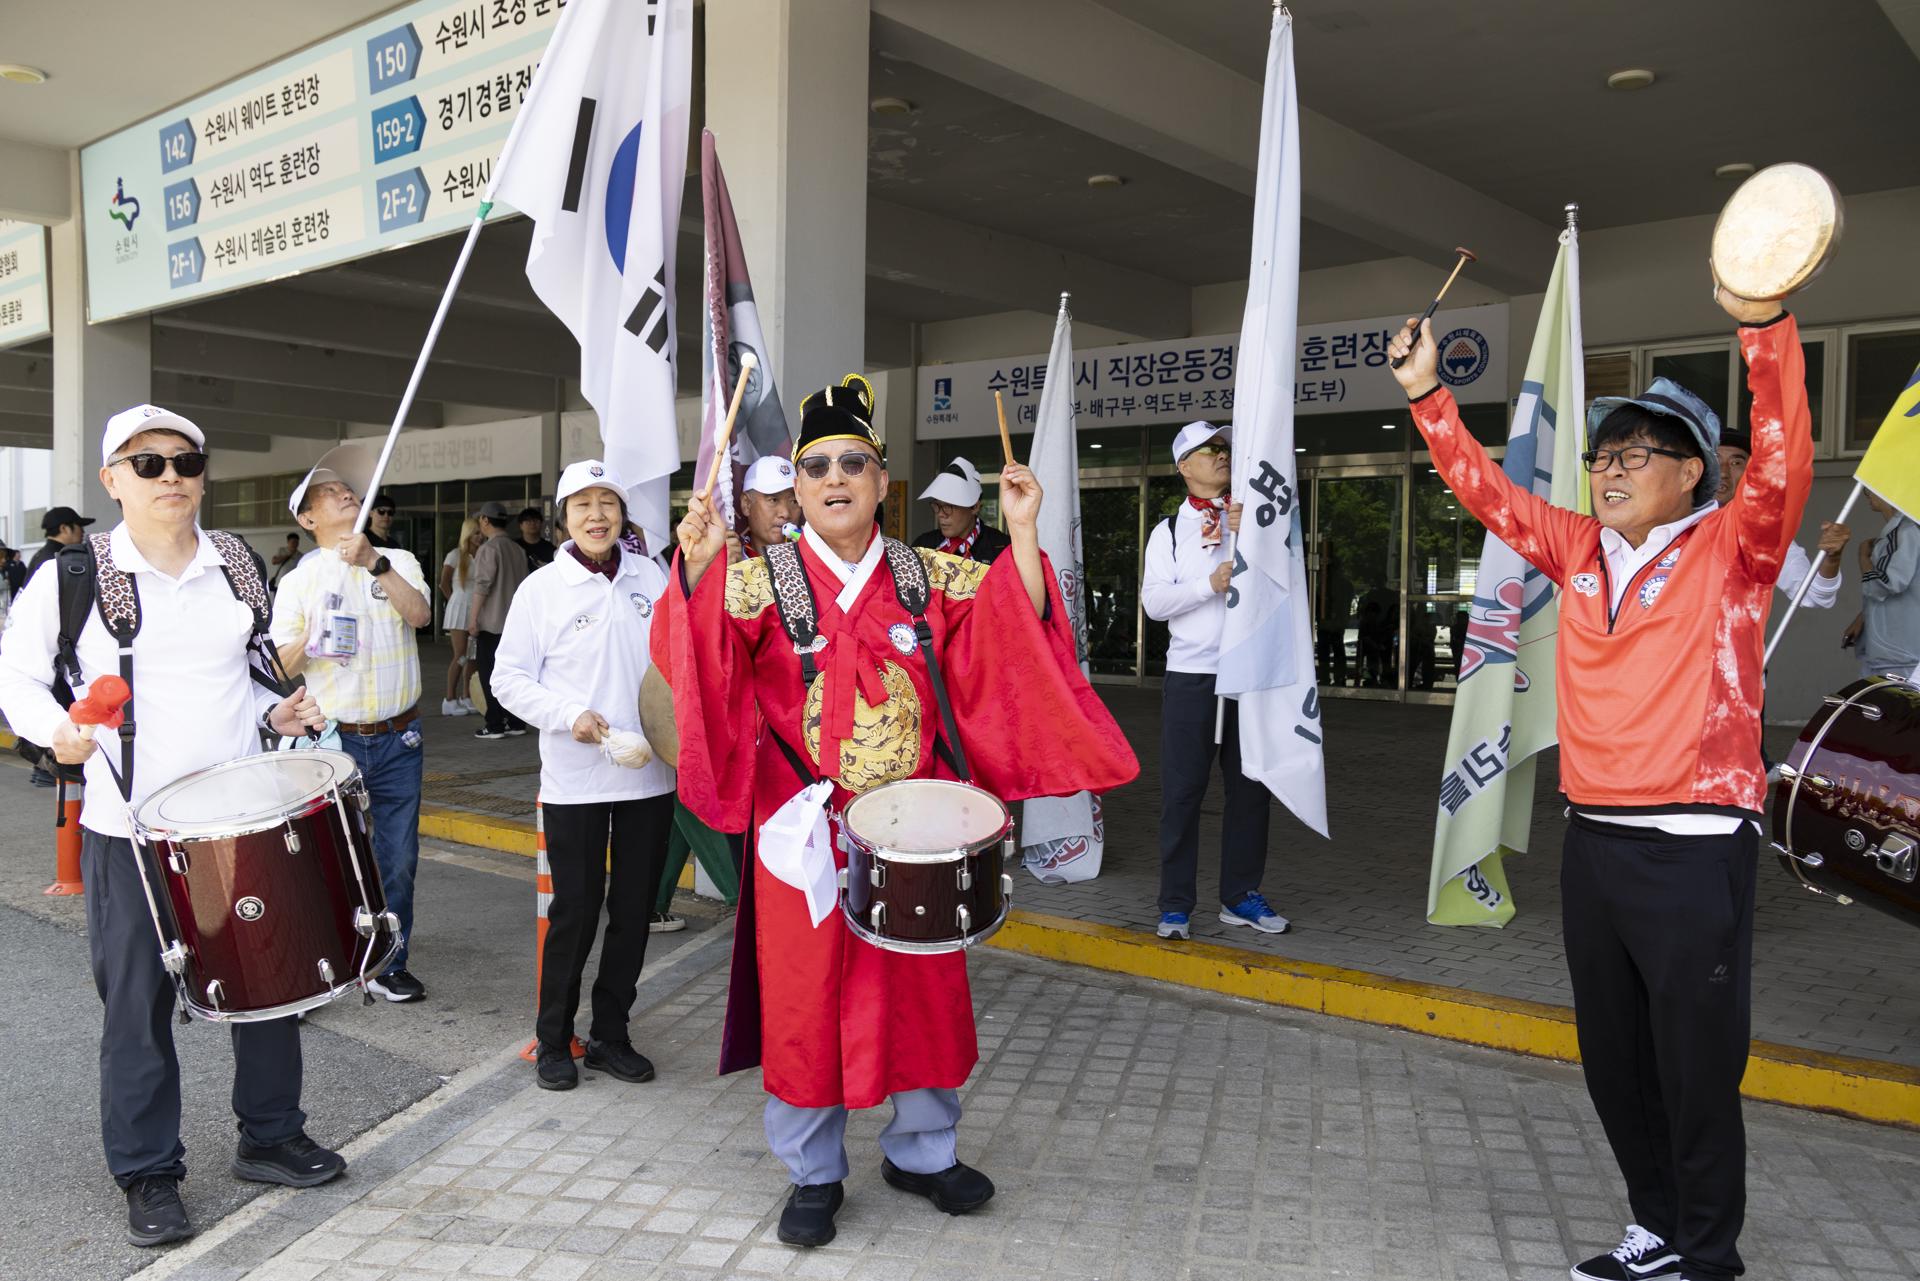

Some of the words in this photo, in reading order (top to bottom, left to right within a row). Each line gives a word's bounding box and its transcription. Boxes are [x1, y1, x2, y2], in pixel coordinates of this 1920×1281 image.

[435, 4, 485, 54] 수원시
[375, 42, 408, 80] 150
[205, 107, 238, 146] 수원시
[241, 93, 278, 129] 웨이트
[281, 73, 320, 116] 훈련장
[439, 62, 540, 131] 경기경찰전
[165, 133, 187, 163] 142
[376, 113, 414, 151] 159-2
[210, 169, 246, 208] 수원시
[250, 161, 276, 193] 역도
[280, 142, 321, 185] 훈련장
[443, 158, 491, 203] 수원시
[169, 192, 191, 221] 156
[382, 184, 417, 221] 2F-2
[214, 232, 248, 268] 수원시
[251, 221, 287, 256] 레슬링
[292, 209, 330, 247] 훈련장
[171, 250, 196, 279] 2F-1
[988, 359, 1098, 397] 수원특시
[1108, 345, 1240, 388] 직장운동경
[1300, 330, 1391, 372] 훈련장
